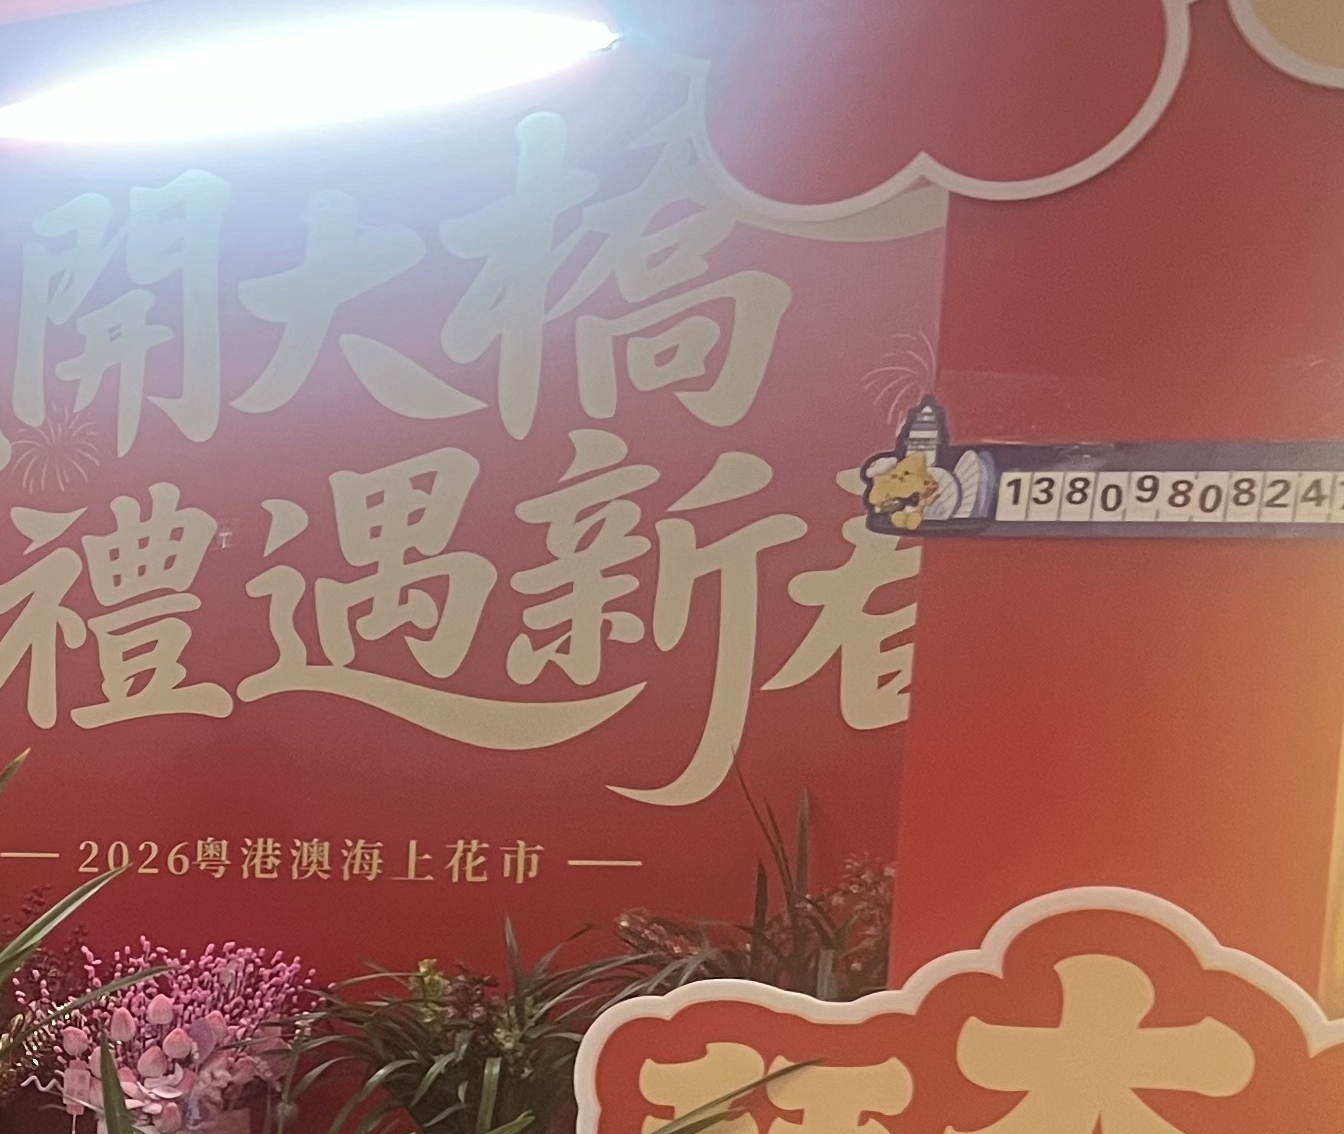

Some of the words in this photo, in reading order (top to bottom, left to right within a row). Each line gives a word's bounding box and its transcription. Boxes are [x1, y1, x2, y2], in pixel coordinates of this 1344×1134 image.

[1006, 473, 1344, 514] 1380980824
[78, 837, 545, 885] 2026粤港澳海上花市
